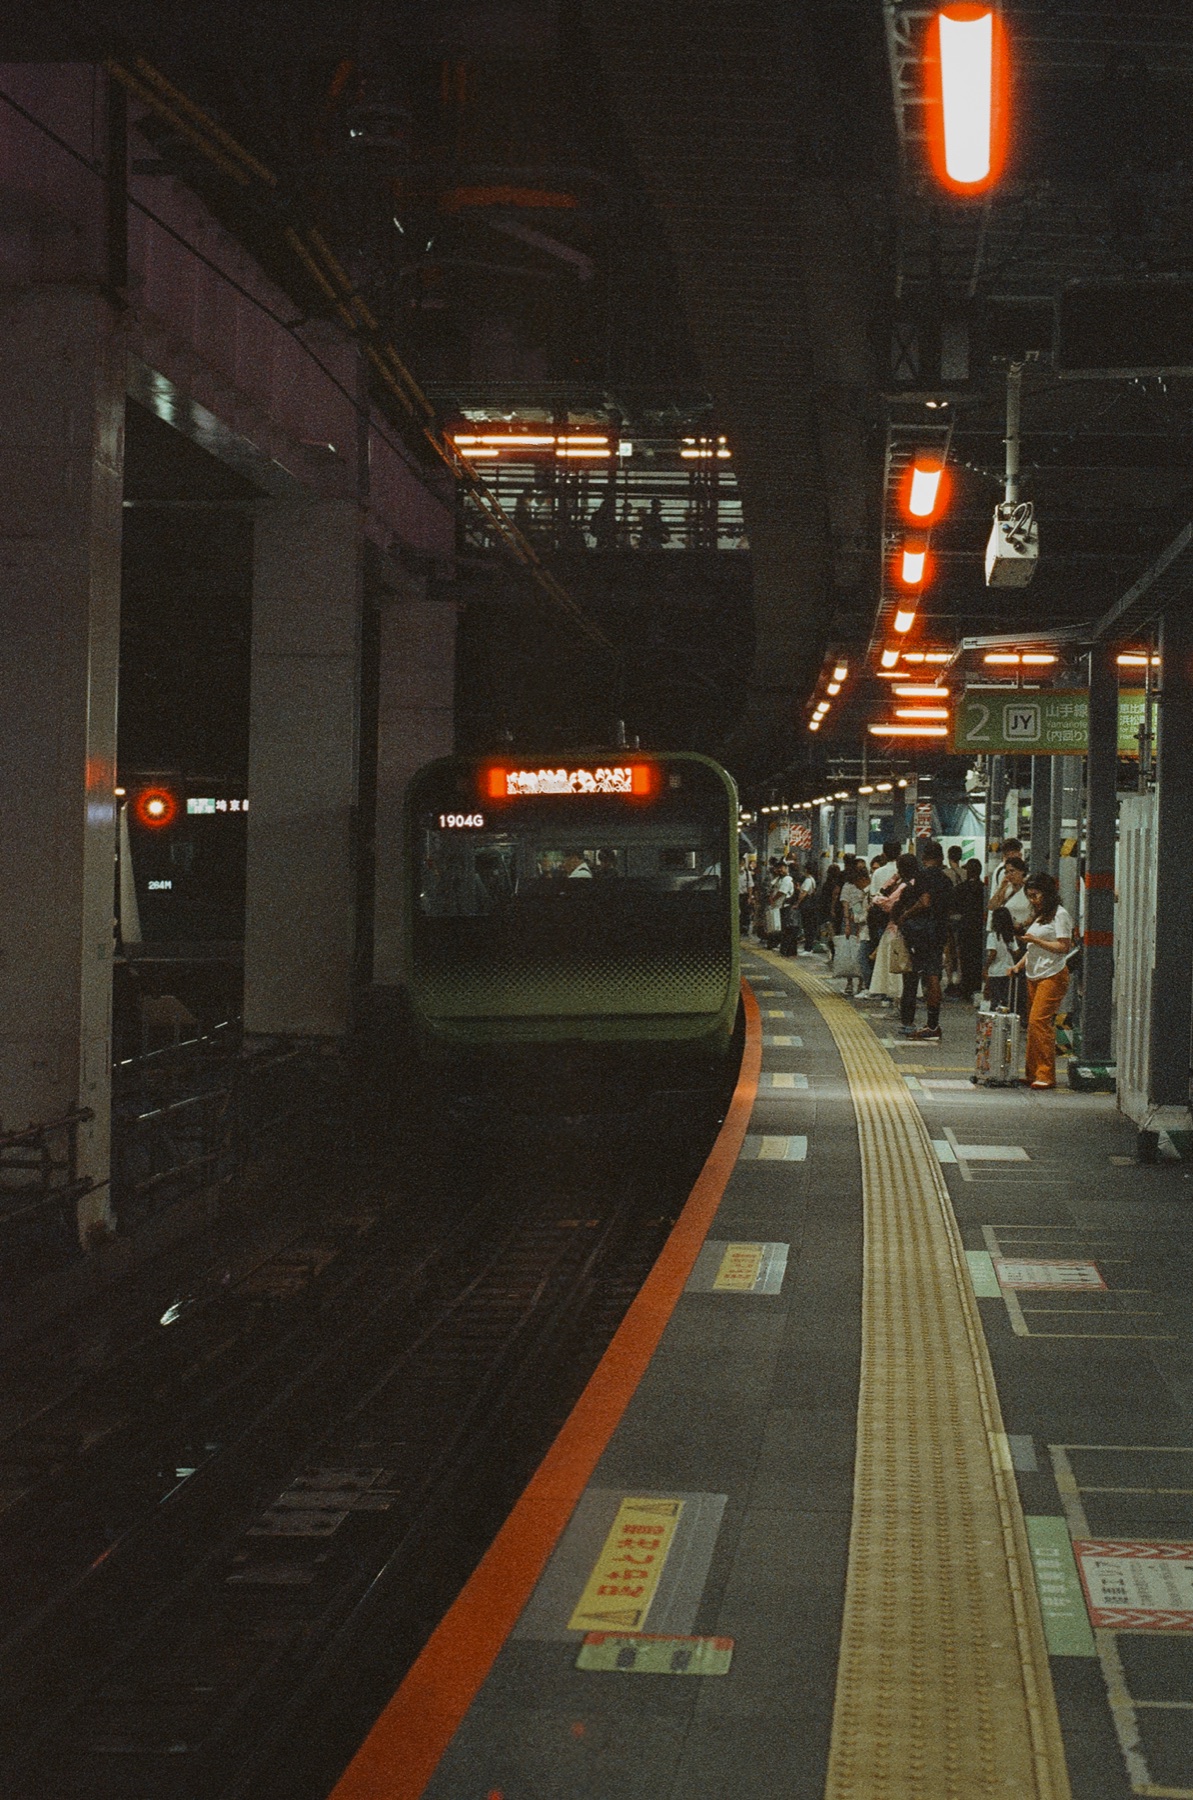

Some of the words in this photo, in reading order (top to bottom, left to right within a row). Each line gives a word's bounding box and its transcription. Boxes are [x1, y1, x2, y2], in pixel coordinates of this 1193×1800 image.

[1045, 703, 1088, 718] 山手線
[966, 703, 990, 741] 2
[1011, 714, 1032, 730] JY
[1046, 730, 1089, 742] (内回り)
[439, 814, 484, 828] 1904G
